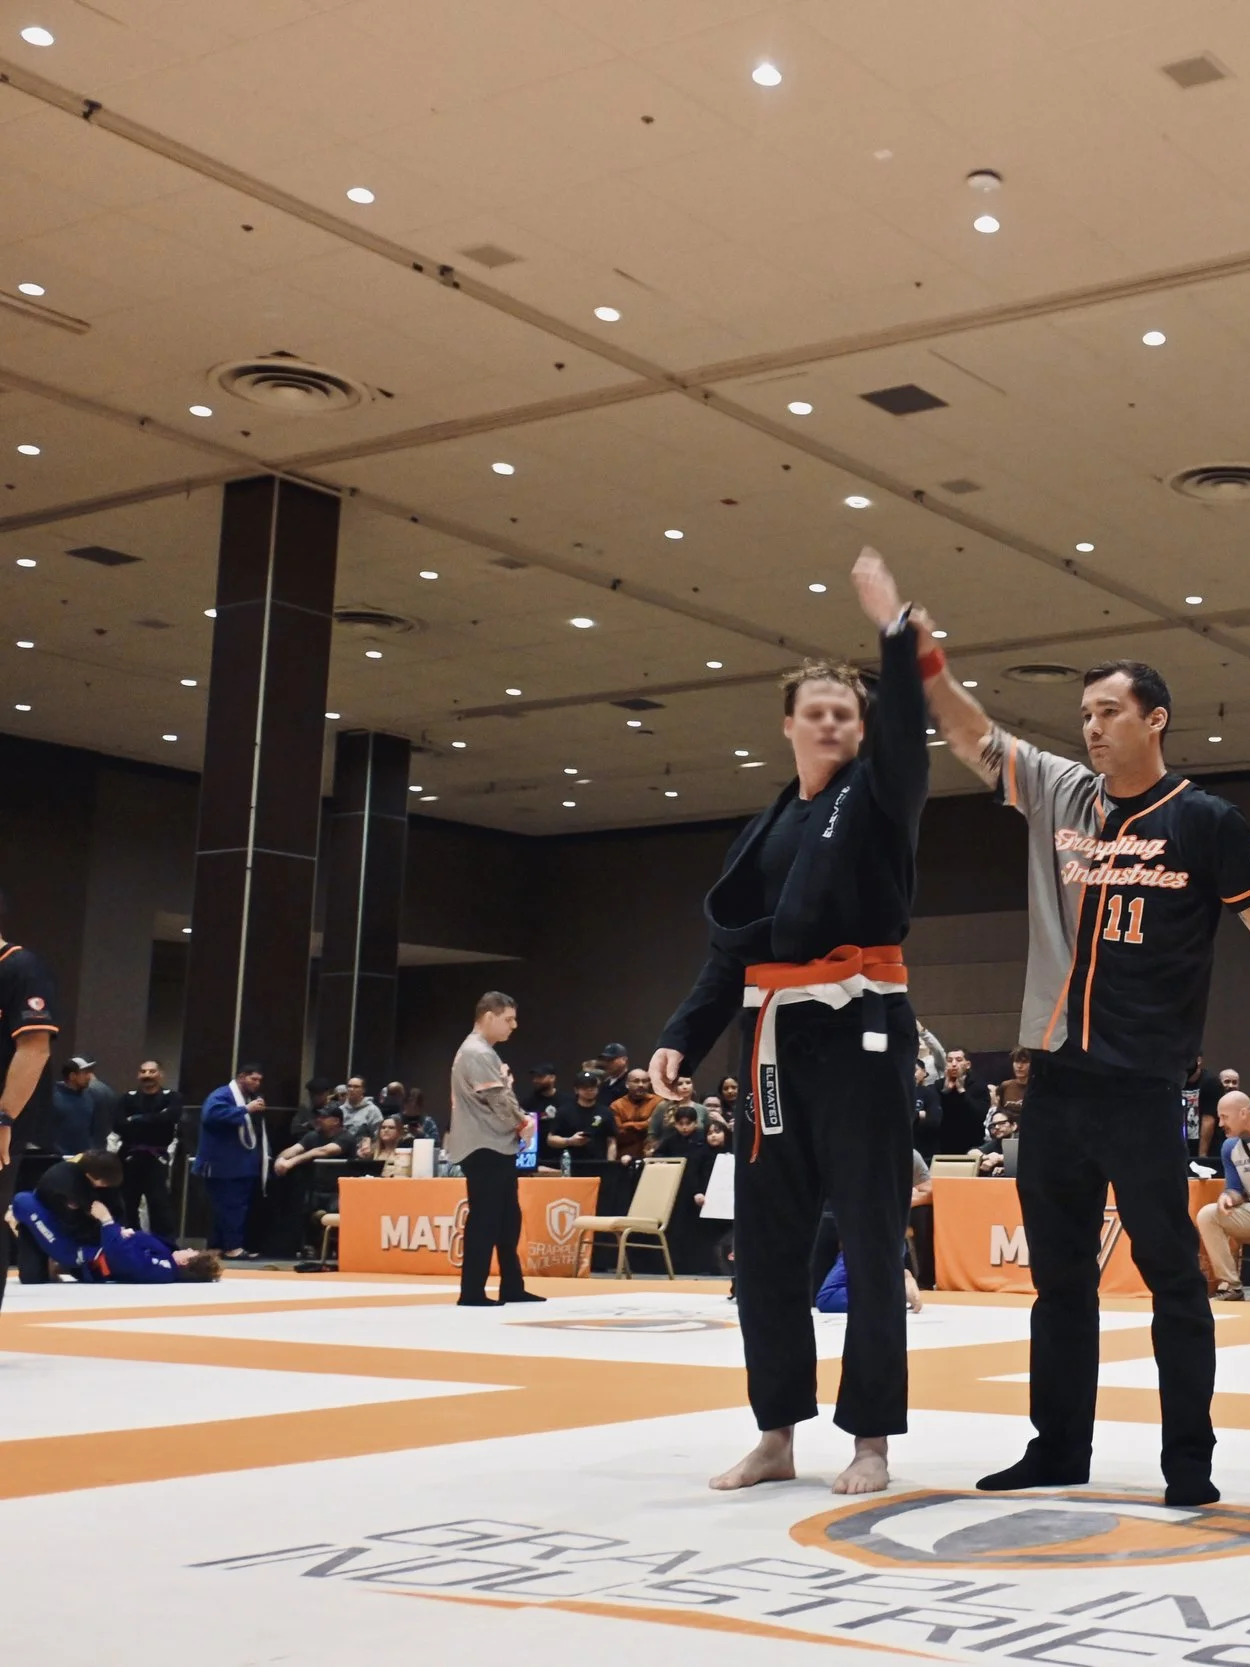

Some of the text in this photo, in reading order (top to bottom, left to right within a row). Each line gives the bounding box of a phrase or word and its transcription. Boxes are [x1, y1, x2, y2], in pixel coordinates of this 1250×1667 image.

[1055, 829, 1168, 860] Grappling
[1061, 861, 1189, 889] Industries
[1103, 894, 1145, 944] 11
[766, 1066, 778, 1125] ELEVATED
